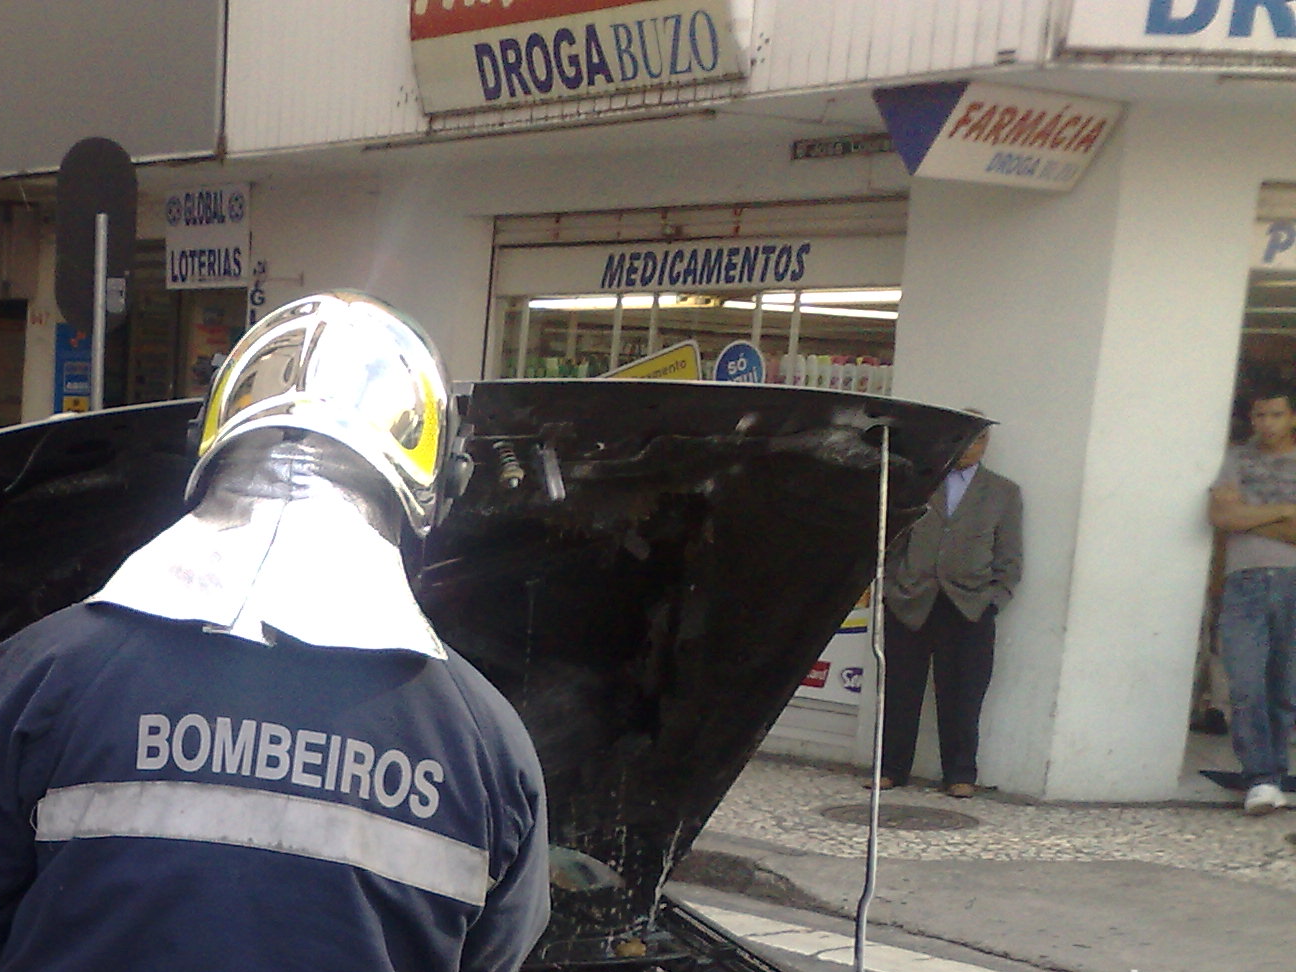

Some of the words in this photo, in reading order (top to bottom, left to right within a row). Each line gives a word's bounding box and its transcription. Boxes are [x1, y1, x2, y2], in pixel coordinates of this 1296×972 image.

[948, 101, 1107, 153] FARMÁCIA
[184, 190, 226, 226] GLOBAL
[170, 247, 242, 282] LOTERIAS
[601, 242, 811, 289] MEDICAMENTOS
[727, 352, 747, 375] SÓ
[136, 713, 445, 819] BOMBEIROS
